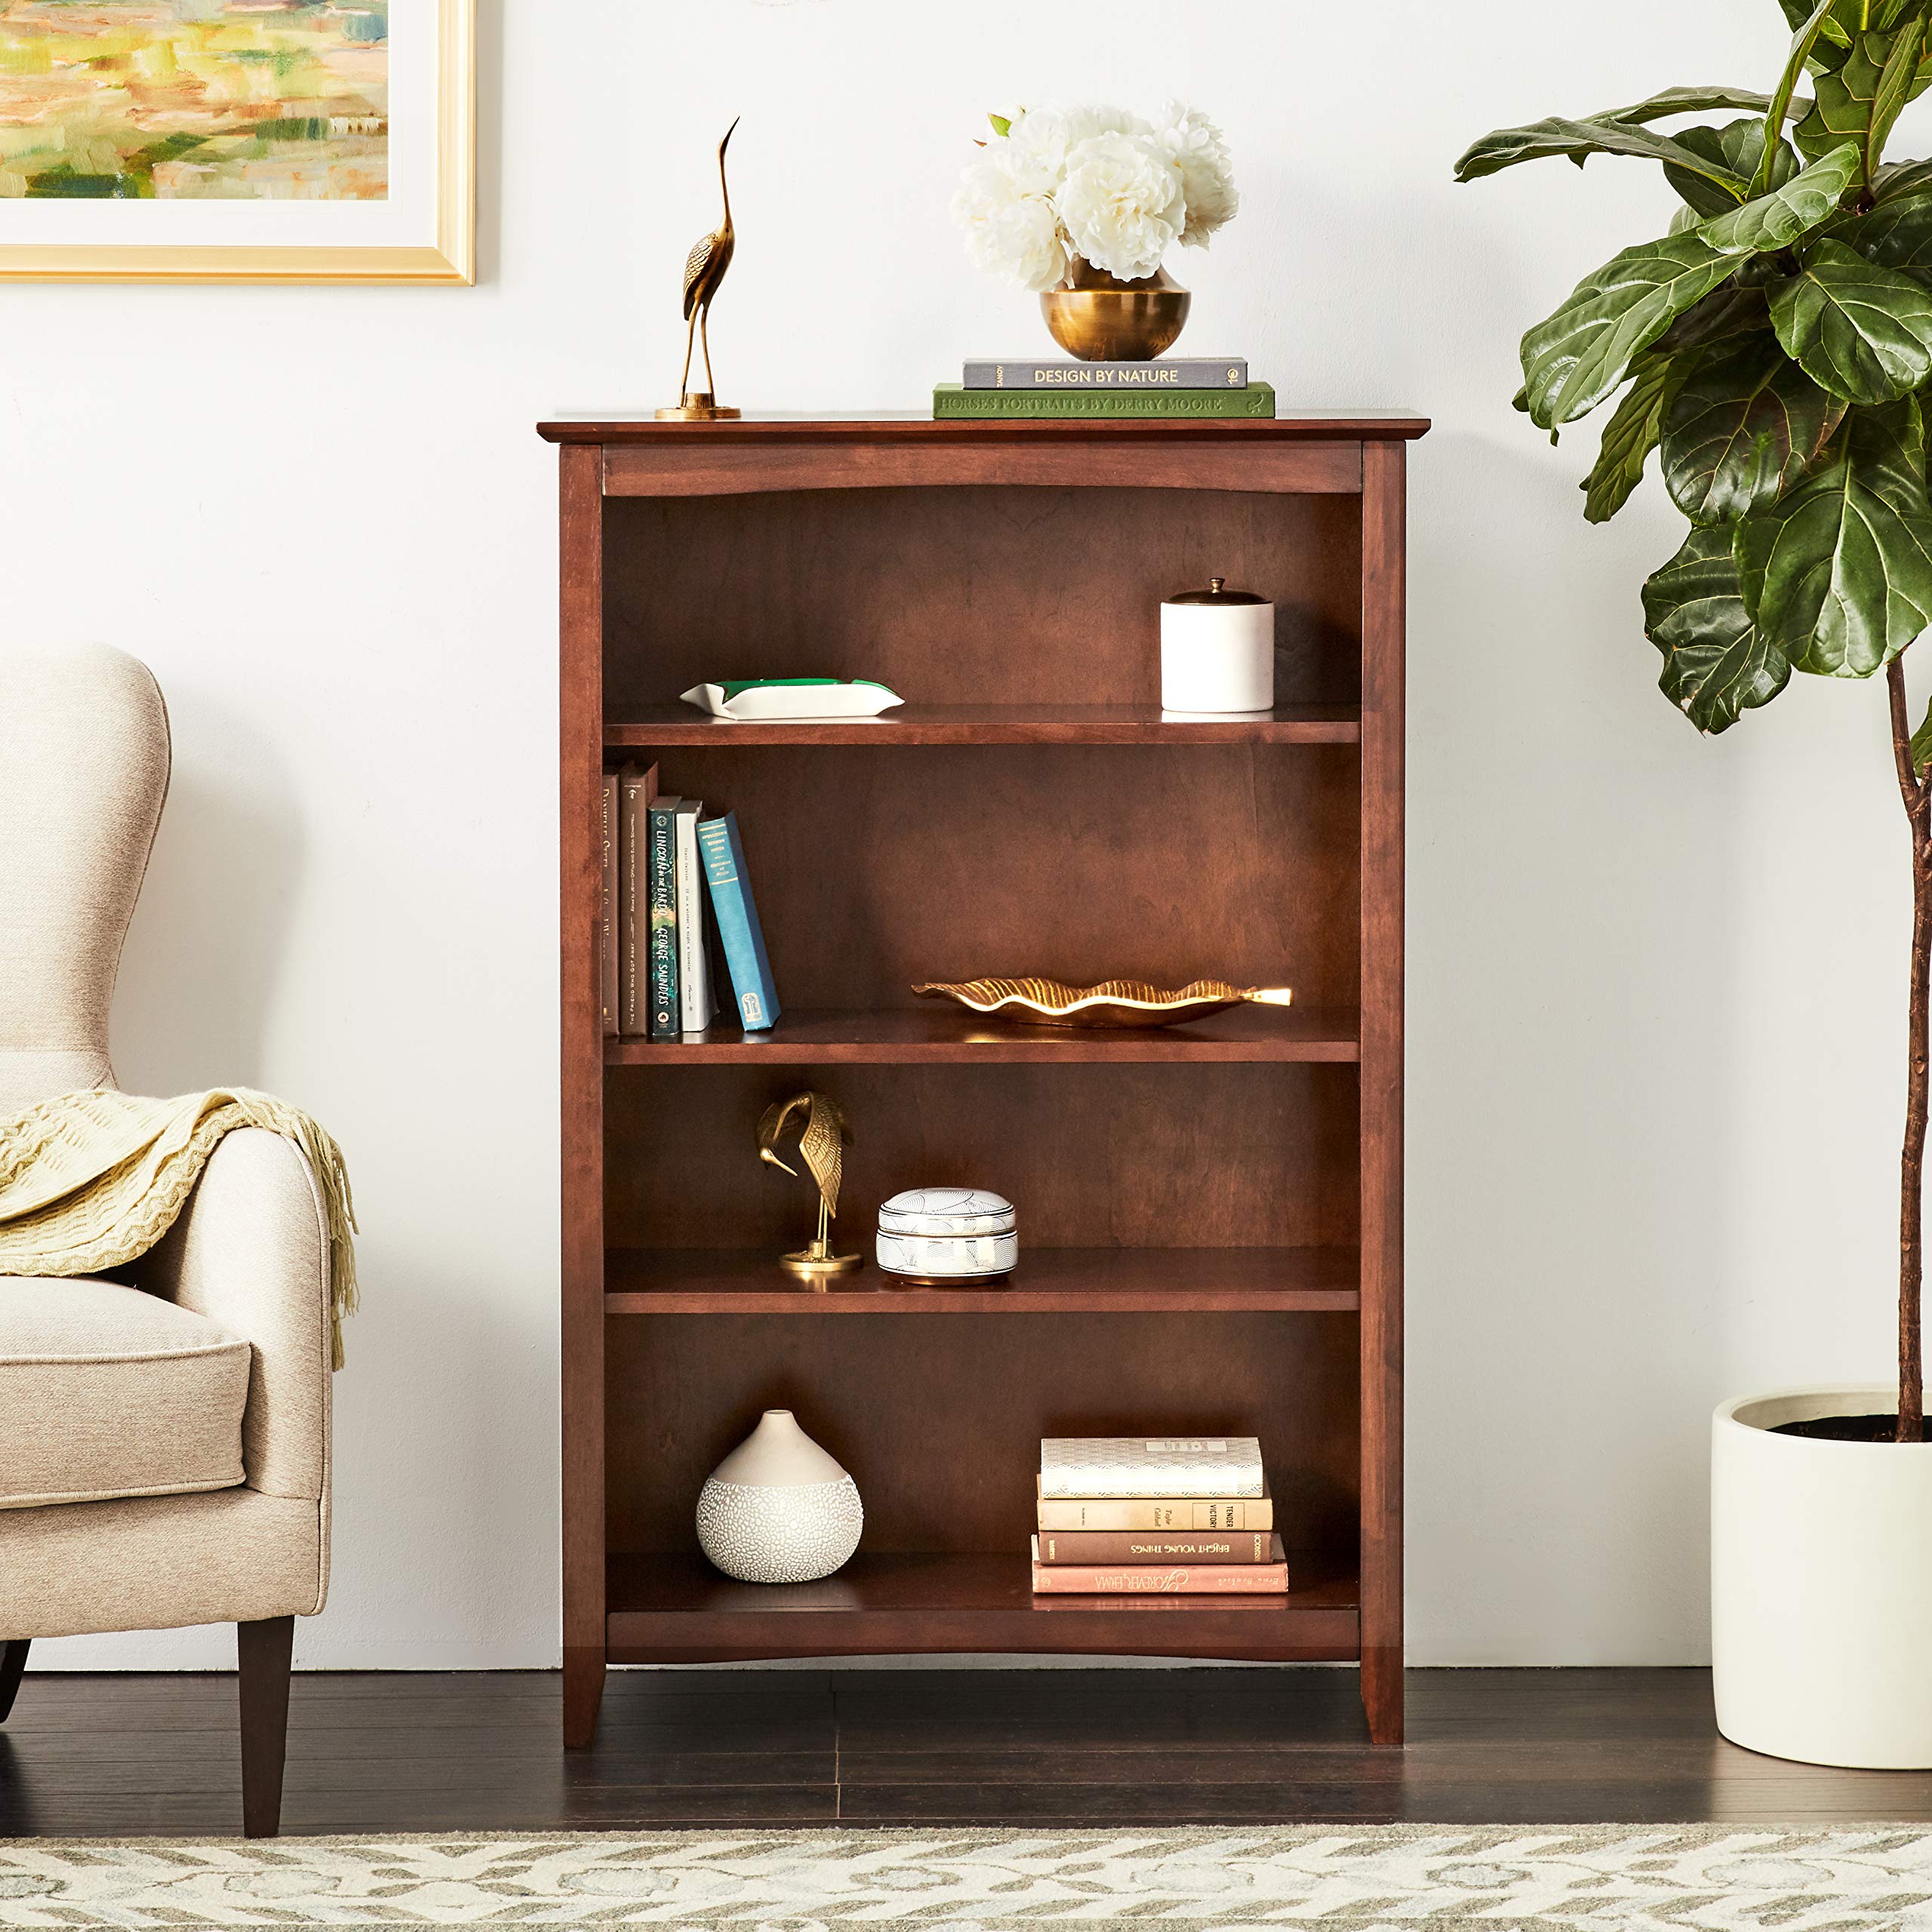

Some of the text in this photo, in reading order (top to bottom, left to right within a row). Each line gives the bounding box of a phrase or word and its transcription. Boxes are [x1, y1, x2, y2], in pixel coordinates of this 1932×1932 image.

[1034, 369, 1178, 383] DESIGN BY NATURE
[941, 398, 1223, 410] HORSES PORTRAITS BY DERRY MOORE
[657, 830, 667, 870] LINCOLN
[657, 888, 668, 916] BARDO
[656, 928, 669, 1006] GEORGE SAUNDERS
[1164, 1509, 1172, 1525] Taylor
[1209, 1504, 1217, 1528] VICTORY
[1225, 1506, 1233, 1527] TENDER
[1131, 1543, 1230, 1553] BRIGHT YOUNG THINGS
[1094, 1576, 1123, 1590] ERMA
